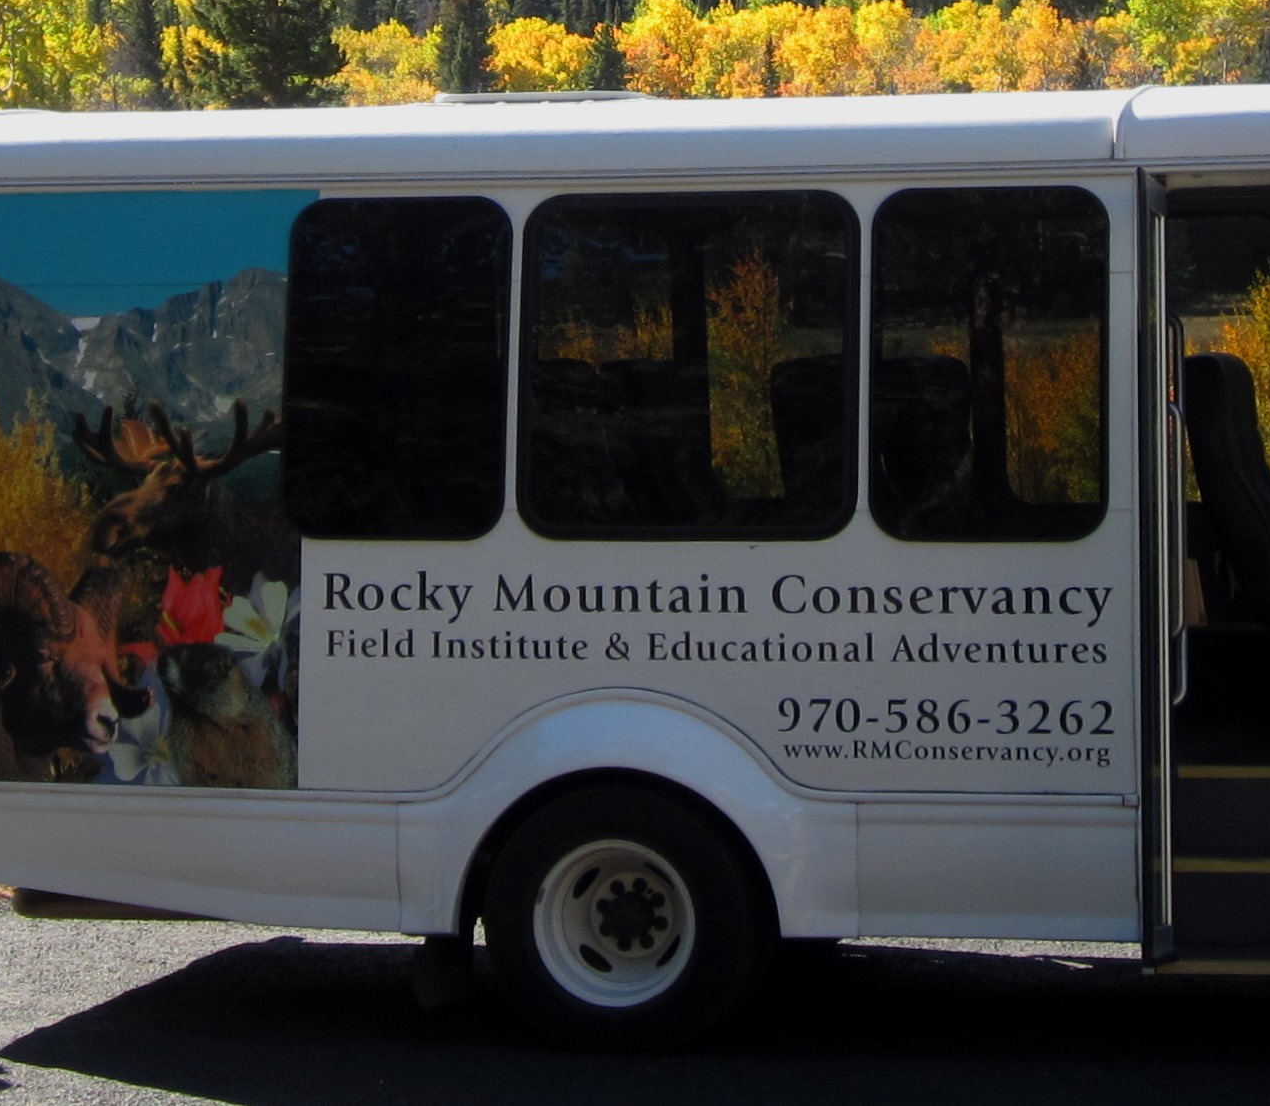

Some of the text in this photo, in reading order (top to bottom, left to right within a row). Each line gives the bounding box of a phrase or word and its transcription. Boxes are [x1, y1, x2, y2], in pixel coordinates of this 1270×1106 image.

[323, 571, 1113, 627] Rocky Mountain Conservancy
[327, 629, 1108, 665] Field Institute & Educational Adventures
[777, 697, 1116, 736] 970-586-3262
[783, 739, 1111, 768] www.RMConservancy.org
